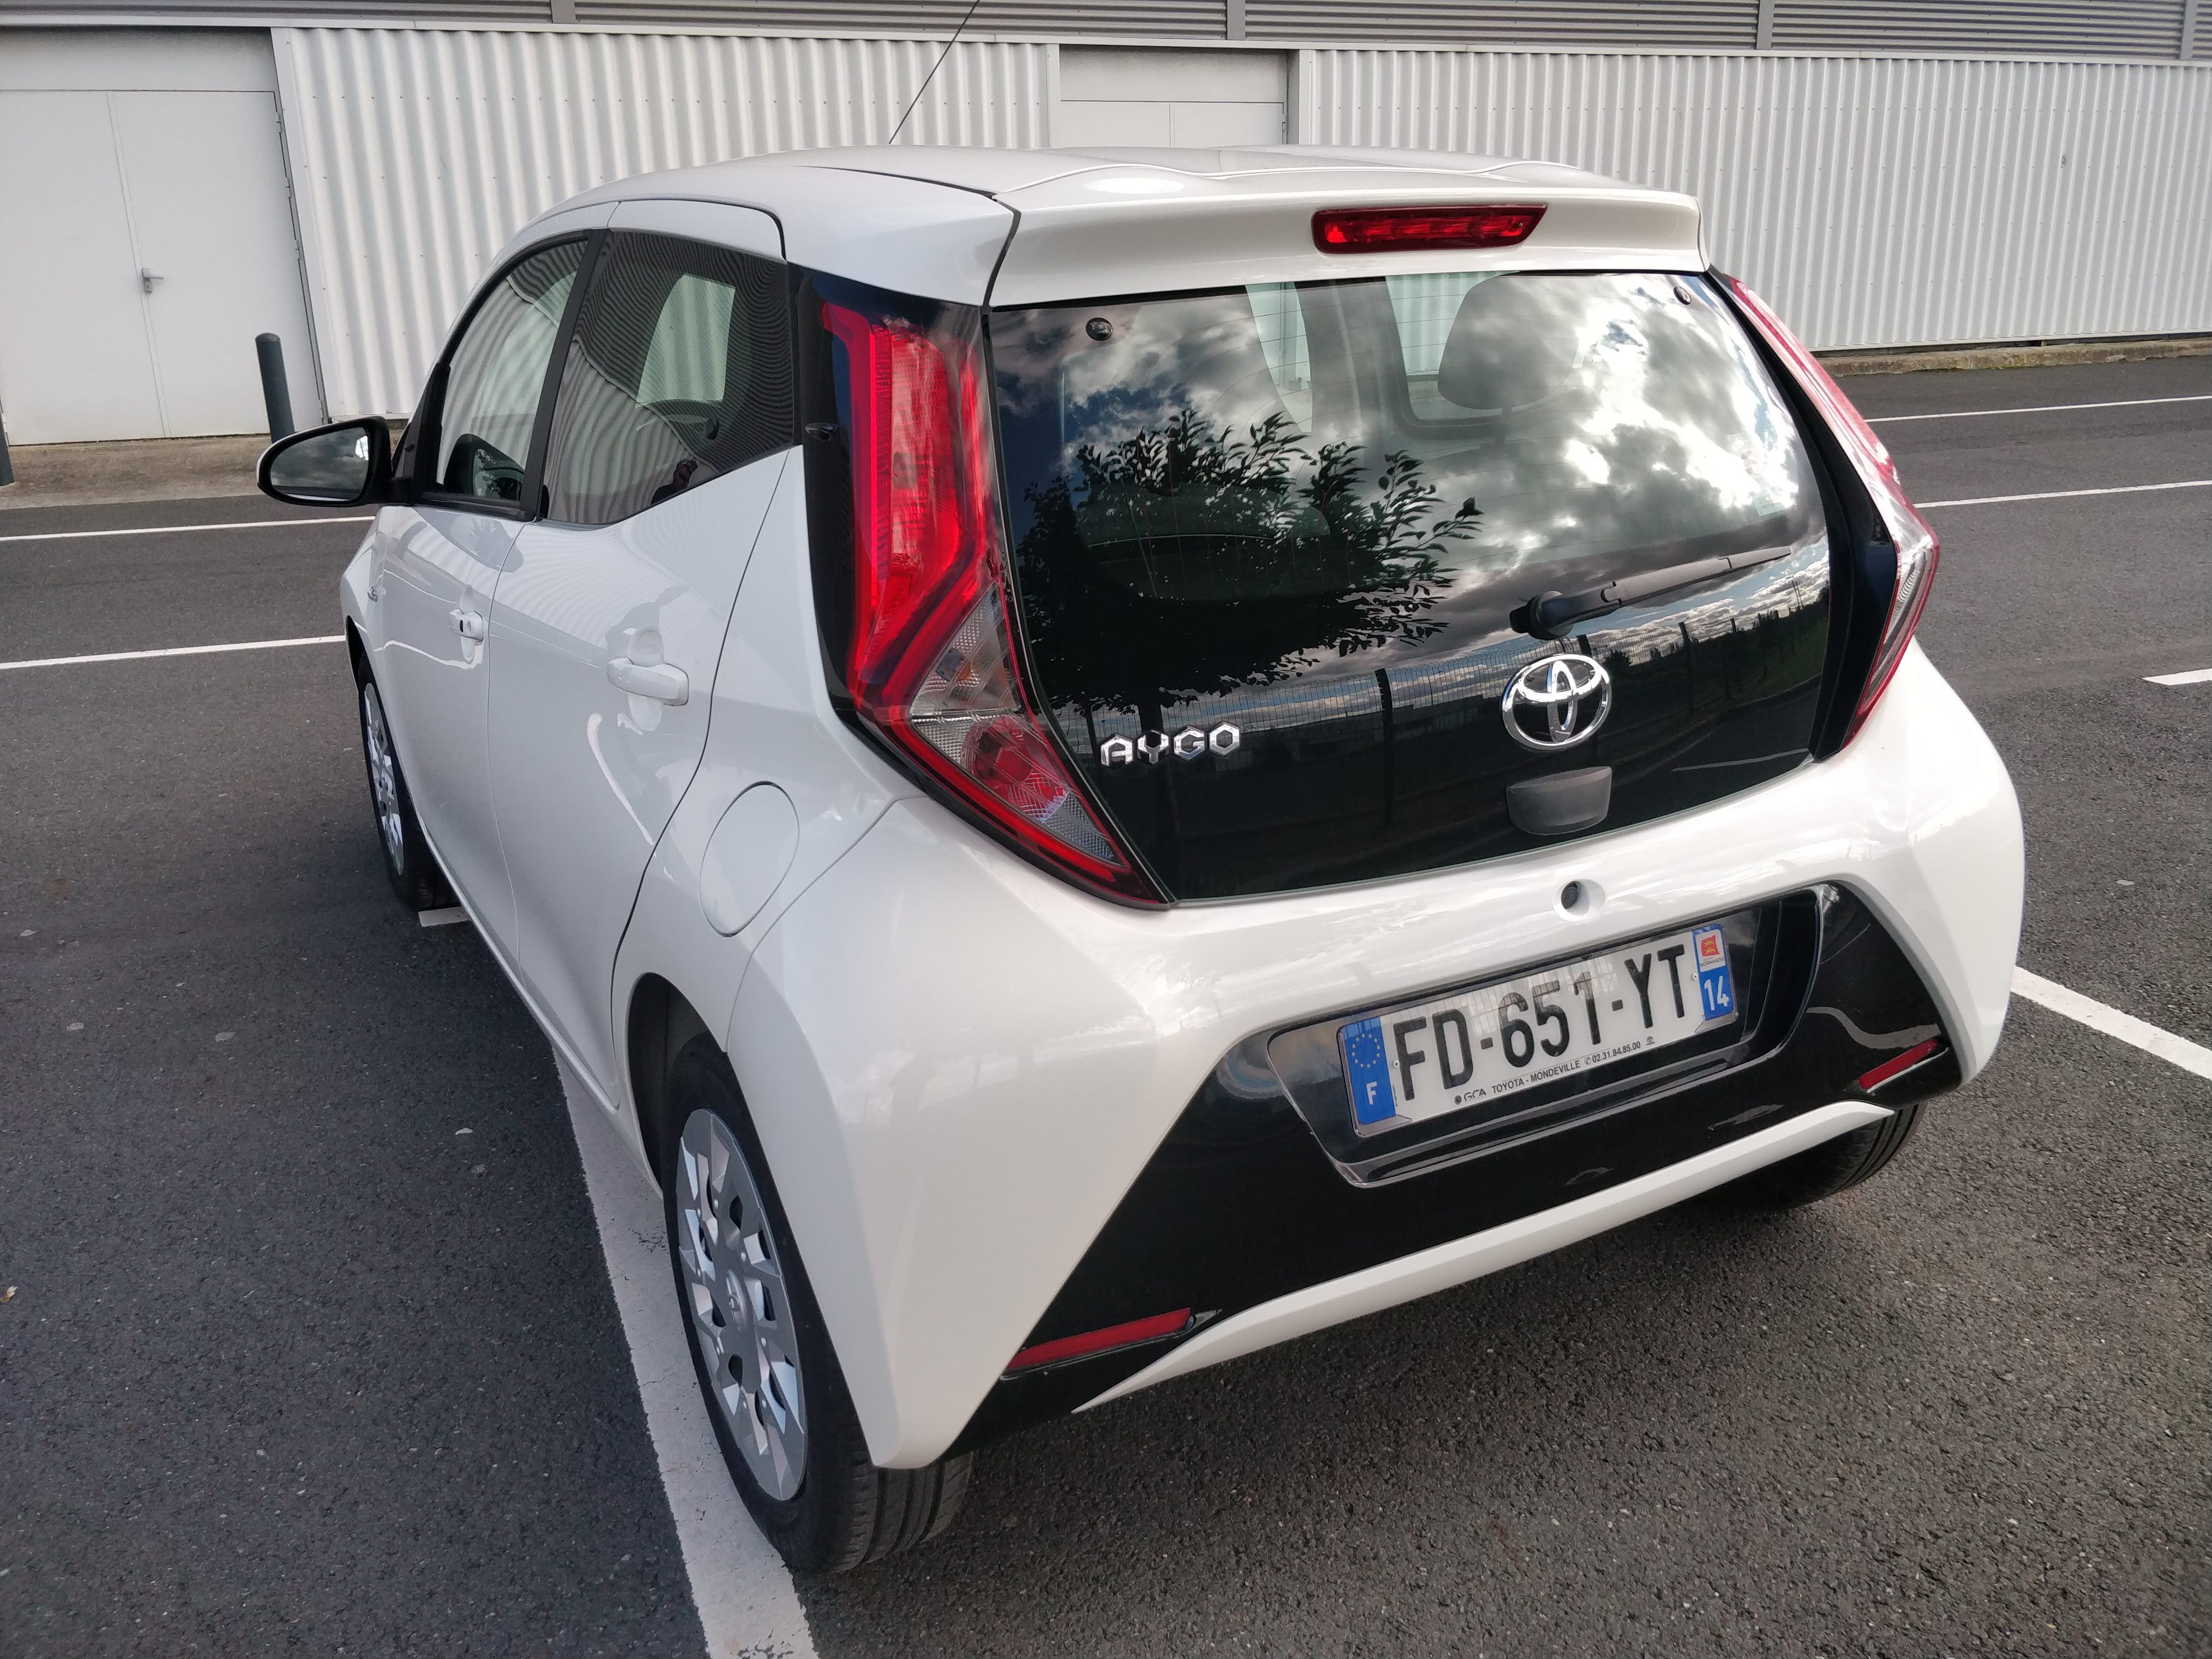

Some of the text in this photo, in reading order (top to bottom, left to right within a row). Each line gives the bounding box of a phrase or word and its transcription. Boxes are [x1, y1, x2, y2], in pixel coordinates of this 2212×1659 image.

[1100, 721, 1240, 767] AYGO
[1704, 975, 1729, 1011] 14
[1393, 944, 1685, 1101] FD-651-YT
[1366, 1081, 1377, 1105] F
[1464, 1088, 1486, 1101] GCA
[1491, 1078, 1524, 1094] TOYOTA
[1530, 1060, 1581, 1083] MONDEVILLE
[1592, 1041, 1641, 1063] 02.31.84.85.00
